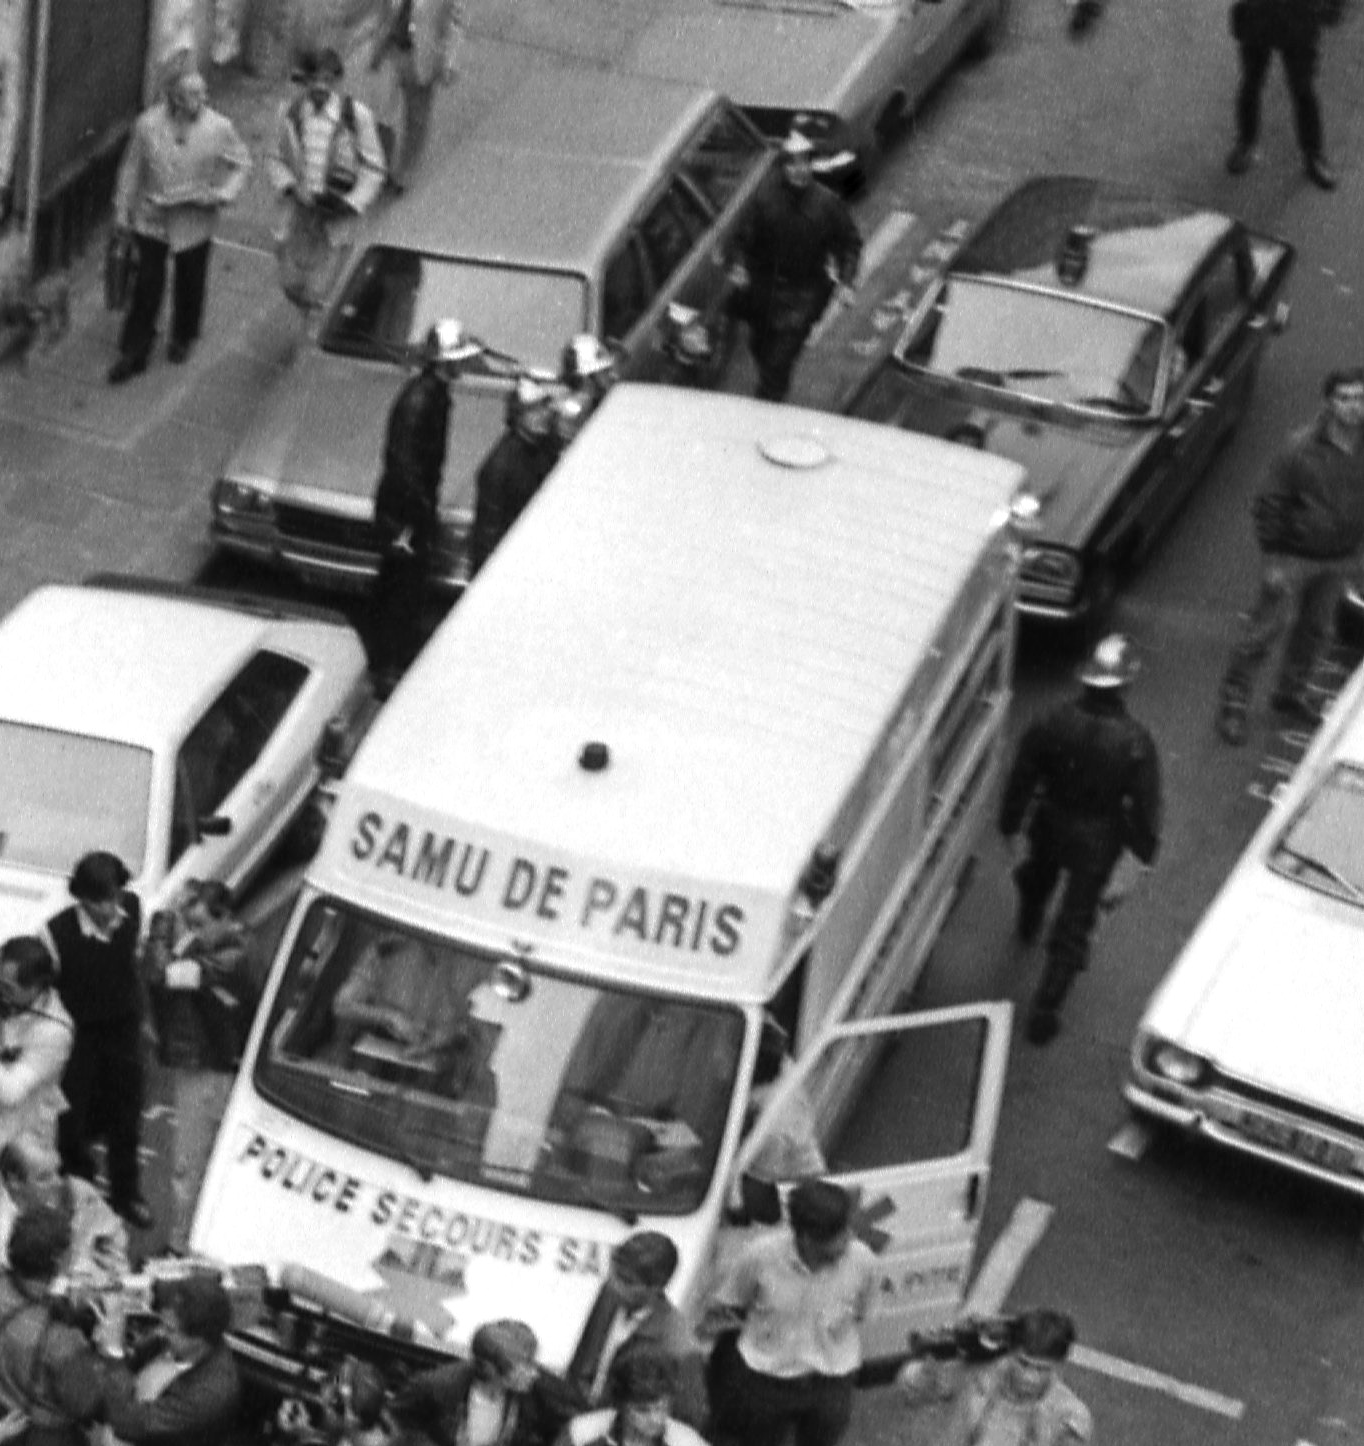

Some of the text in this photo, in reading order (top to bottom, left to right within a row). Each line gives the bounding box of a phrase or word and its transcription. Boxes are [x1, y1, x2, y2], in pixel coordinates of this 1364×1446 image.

[350, 811, 745, 957] SAMU DE PARIS
[239, 1134, 603, 1276] POLICE SECOURS SA
